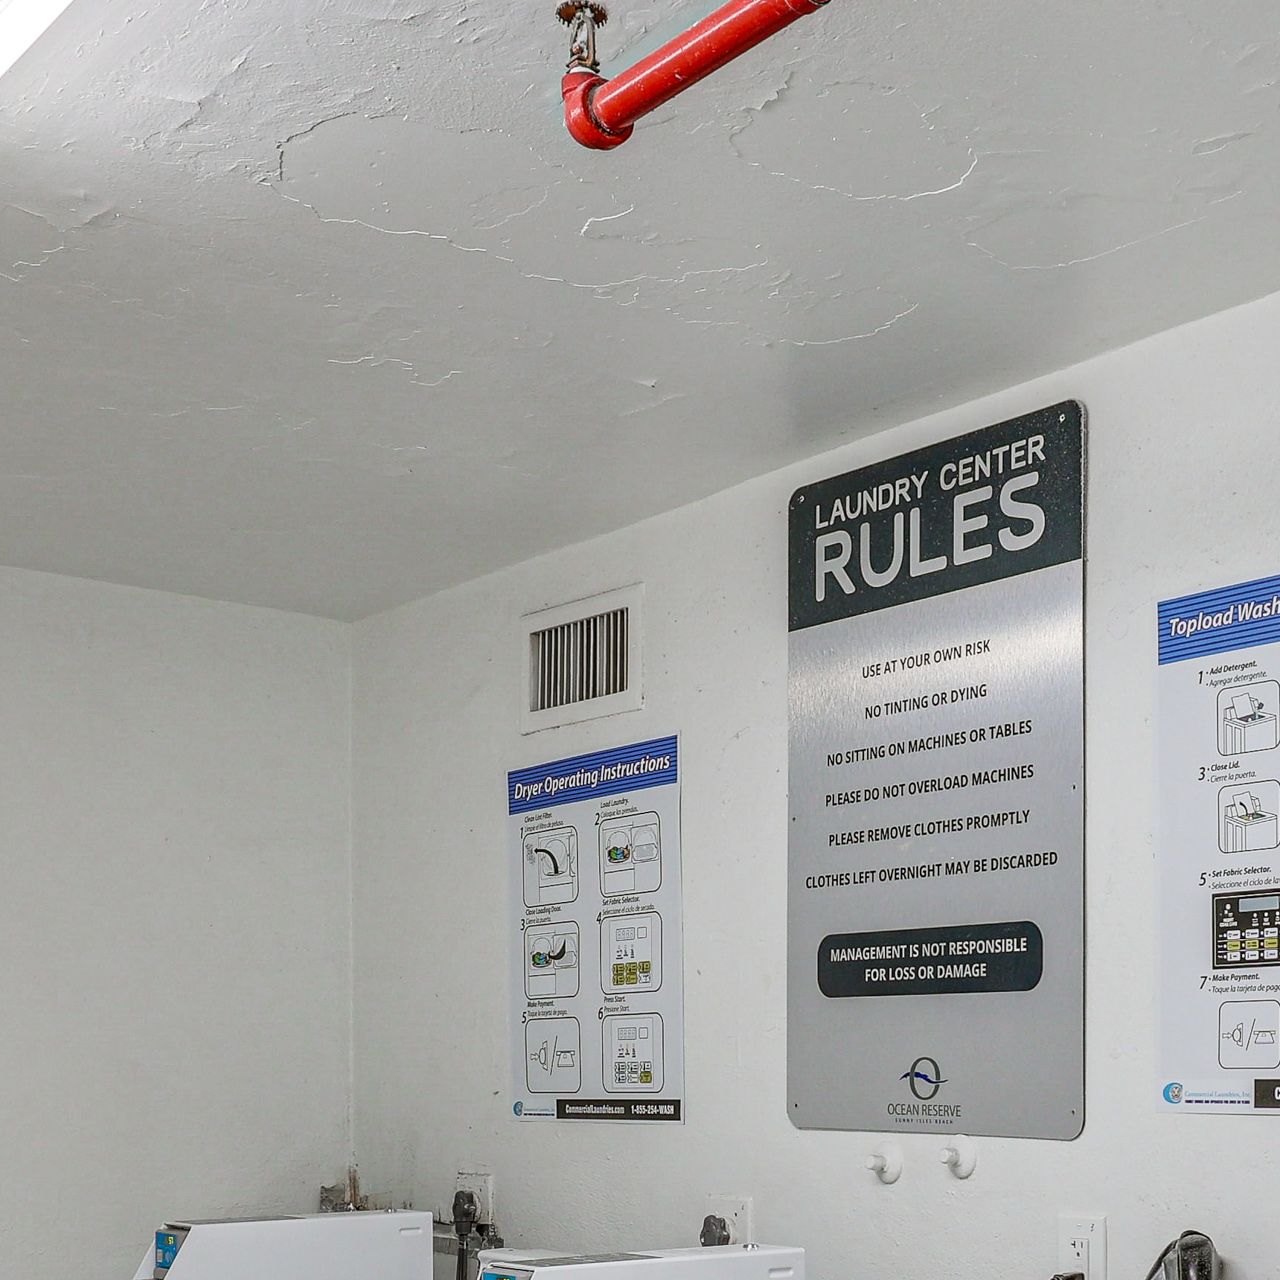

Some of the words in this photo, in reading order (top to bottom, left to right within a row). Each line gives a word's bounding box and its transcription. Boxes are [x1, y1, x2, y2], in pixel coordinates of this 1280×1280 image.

[815, 470, 929, 529] LAUNDRY
[939, 434, 1046, 491] CENTER
[815, 471, 1046, 603] RULES
[1169, 606, 1234, 637] Topload
[862, 663, 881, 678] USE
[883, 659, 897, 674] AT
[899, 653, 930, 669] YOUR
[933, 646, 961, 663] OWN
[965, 639, 990, 656] RISK
[1209, 666, 1222, 675] Add
[1223, 660, 1257, 672] Detergent.
[1198, 670, 1203, 685] 1
[865, 705, 881, 719] NO
[884, 695, 928, 714] TINTING
[931, 692, 947, 706] OR
[950, 684, 986, 702] DYING
[827, 752, 843, 766] NO
[845, 745, 885, 763] SITTING
[888, 742, 904, 756] ON
[908, 731, 966, 752] MACHINES
[969, 728, 986, 742] OR
[989, 720, 1031, 738] TABLES
[1198, 767, 1206, 781] 3
[1210, 763, 1227, 771] Close
[1228, 760, 1240, 769] Lid.
[514, 783, 544, 801] Dryer
[545, 769, 598, 793] Operating
[601, 755, 670, 780] Instructions
[825, 790, 861, 806] PLEASE
[864, 787, 879, 801] DO
[882, 783, 905, 798] NOT
[908, 775, 968, 794] OVERLOAD
[971, 765, 1033, 785] MACHINES
[829, 830, 864, 846] PLEASE
[867, 825, 911, 841] REMOVE
[914, 818, 963, 835] CLOTHES
[966, 810, 1029, 829] PROMPTLY
[805, 873, 850, 888] CLOTHES
[853, 870, 876, 884] LEFT
[878, 863, 941, 881] OVERNIGHT
[945, 860, 970, 875] MAY
[973, 858, 987, 872] BE
[990, 852, 1057, 870] DISCARDED
[1198, 872, 1207, 886] 5
[1222, 868, 1242, 876] Fabric
[1243, 866, 1271, 874] Selector.
[830, 945, 906, 961] MANAGEMENT
[909, 944, 919, 957] IS
[921, 942, 946, 956] NOT
[949, 938, 1026, 954] RESPONSIBLE
[865, 968, 886, 981] FOR
[888, 966, 915, 980] LOSS
[917, 965, 934, 979] OR
[937, 963, 986, 978] DAMAGE
[1199, 976, 1207, 990] 7
[1230, 973, 1260, 981] Payment.
[887, 1103, 919, 1115] OCEAN
[921, 1104, 961, 1117] RESERVE
